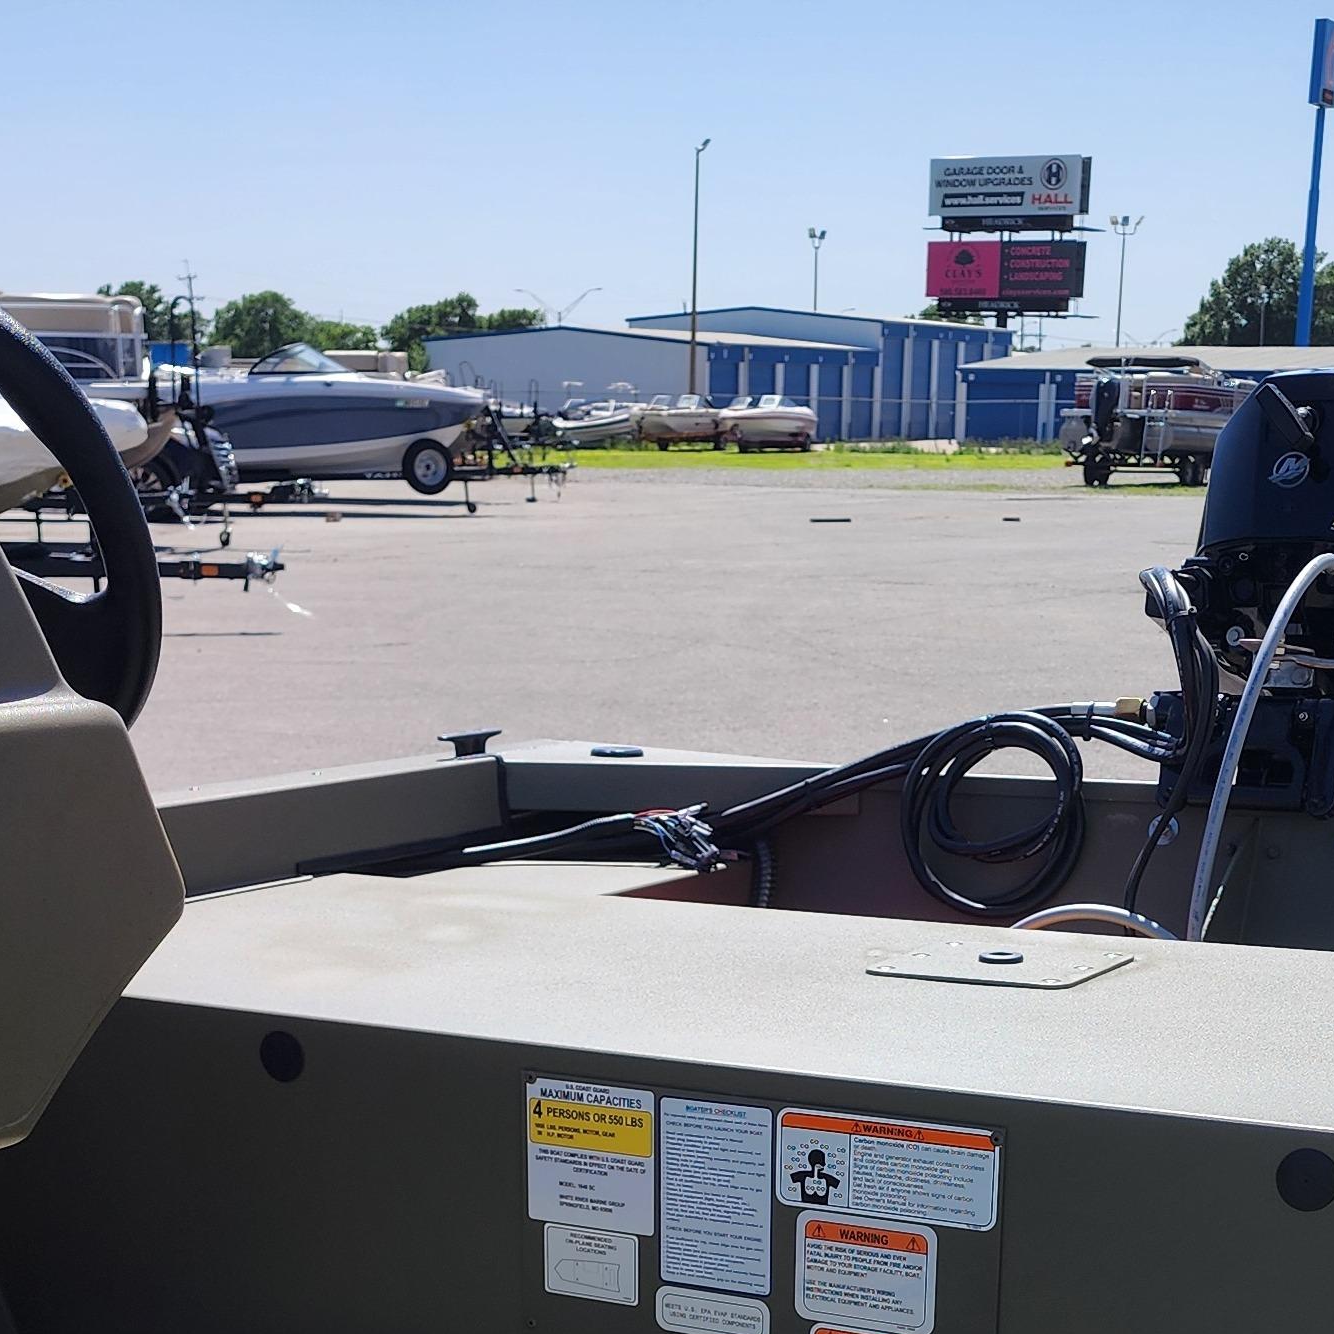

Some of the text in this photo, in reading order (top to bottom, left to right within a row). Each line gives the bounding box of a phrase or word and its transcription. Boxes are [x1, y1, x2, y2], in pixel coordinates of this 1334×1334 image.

[944, 166, 983, 176] GARAGE
[986, 165, 1014, 175] DOOR
[936, 177, 1033, 188] WINDOW UPGRADES
[1032, 194, 1073, 204] HALL
[1010, 246, 1052, 255] CONCRETE
[1009, 259, 1070, 268] CONSTRUCTION
[1008, 272, 1062, 281] LANDSCAPING
[540, 1088, 642, 1109] MAXIMUM CAPACITIES
[533, 1100, 543, 1119] 4
[714, 1108, 746, 1118] CHECKLIST
[547, 1106, 644, 1128] PERSONS OR 550 LBS
[862, 1124, 913, 1137] WARNING
[854, 1137, 874, 1145] Carbon
[876, 1140, 904, 1148] monoxide
[854, 1150, 872, 1159] Engine
[885, 1154, 911, 1163] generator
[912, 1157, 934, 1165] exhaust
[935, 1160, 958, 1168] contains
[960, 1163, 984, 1171] odorless
[853, 1163, 868, 1171] Signs
[896, 1168, 923, 1176] monoxide
[924, 1171, 952, 1181] poisoning
[910, 1163, 937, 1172] monoxide
[930, 1191, 945, 1199] signs
[871, 1204, 898, 1212] monoxide
[916, 1203, 947, 1211] information
[948, 1206, 976, 1216] regarding
[839, 1228, 889, 1245] WARNING
[576, 1247, 606, 1255] LOCATIONS
[593, 1243, 617, 1251] SEATING
[856, 1249, 878, 1257] SERIOUS
[807, 1257, 828, 1266] DAMAGE
[853, 1264, 877, 1272] STORAGE
[851, 1256, 871, 1264] PEOPLE
[828, 1283, 874, 1294] MANUFACTURER'S
[806, 1286, 842, 1296] INSTRUCTIONS
[860, 1294, 890, 1303] INSTALLING
[806, 1294, 836, 1303] ELECTRICAL
[837, 1298, 867, 1307] EQUIPMENT
[688, 1314, 719, 1324] CERTIFIED
[720, 1319, 755, 1329] COMPONENTS
[730, 1312, 760, 1322] STANDARDS
